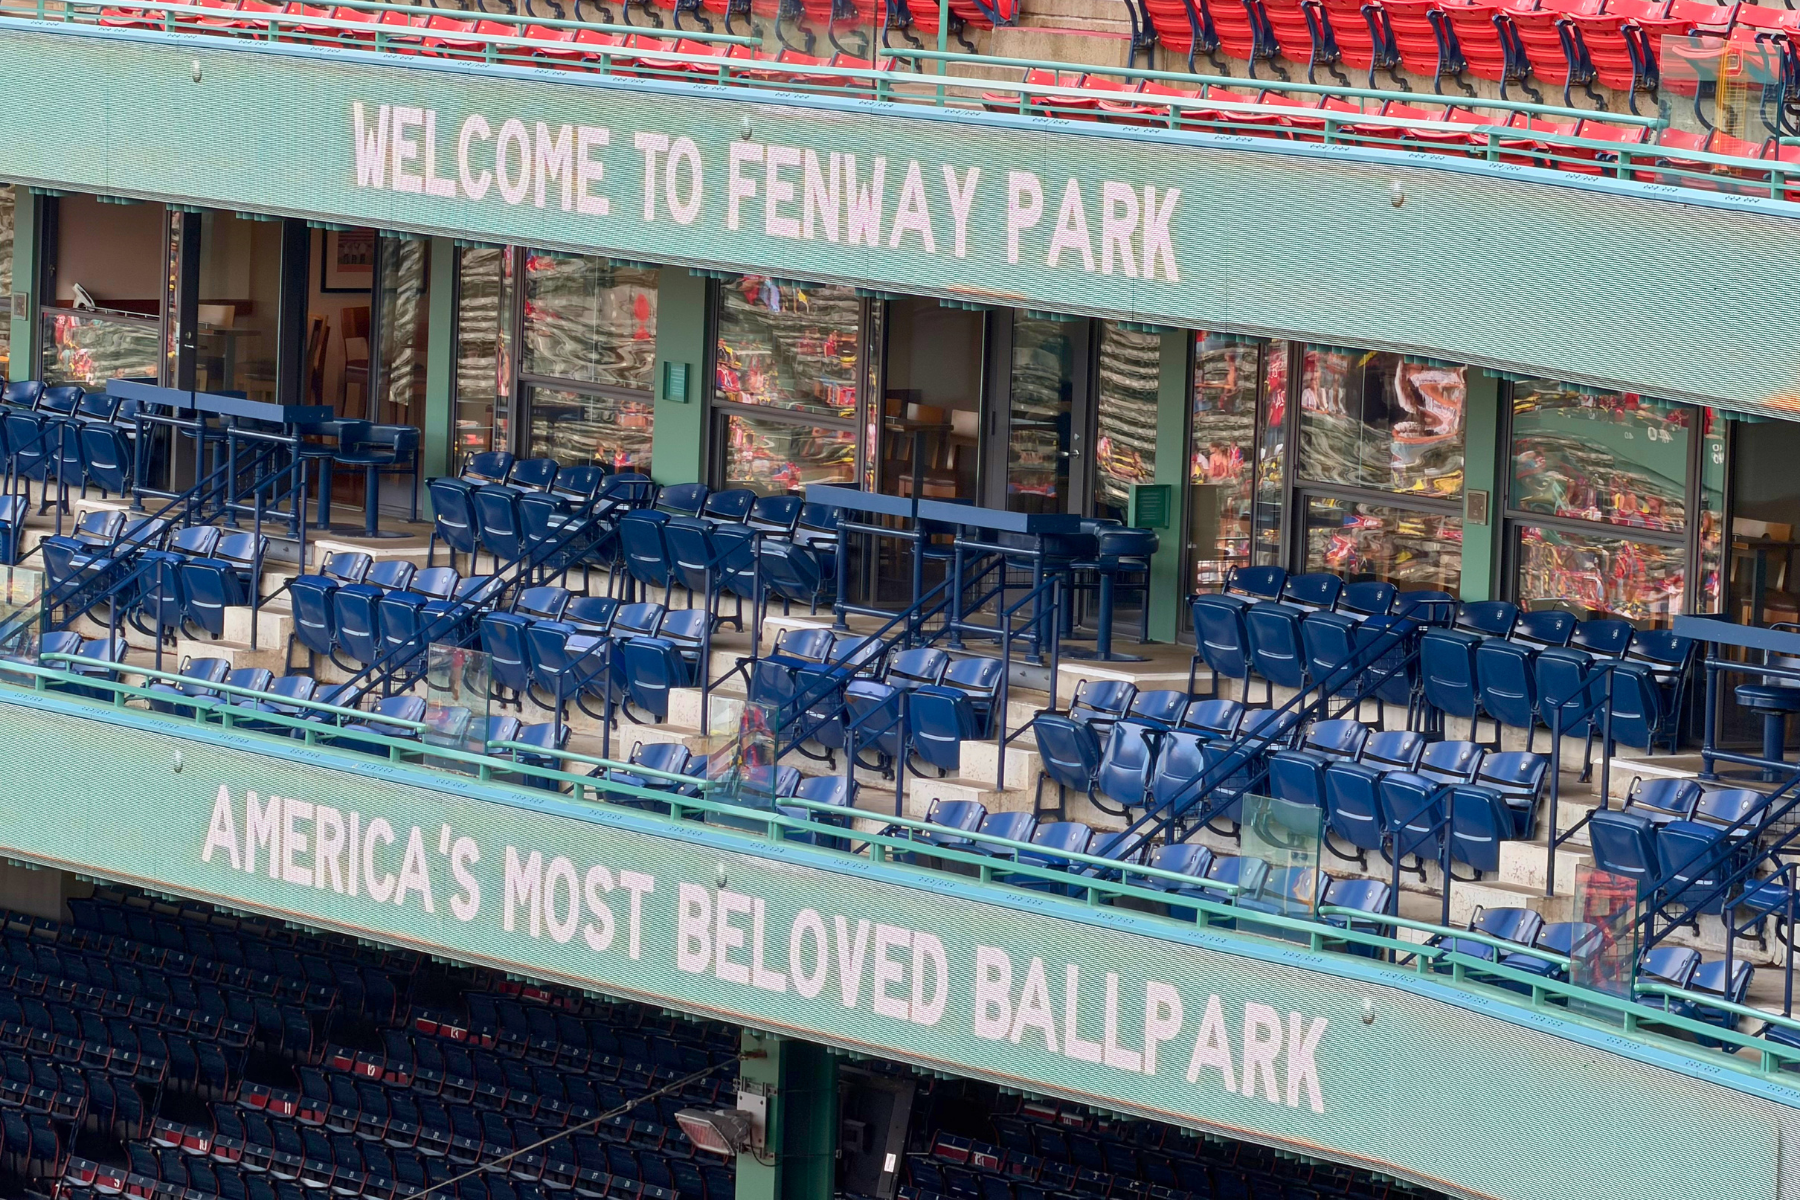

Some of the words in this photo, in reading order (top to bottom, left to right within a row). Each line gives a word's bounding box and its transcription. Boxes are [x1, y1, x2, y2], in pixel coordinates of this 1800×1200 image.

[353, 102, 610, 215] WELCOME
[633, 132, 703, 224] TO
[726, 138, 981, 258] FENWAY
[1006, 170, 1181, 282] PARK
[202, 785, 480, 921] AMERICA'S
[503, 846, 655, 959] MOST
[677, 882, 948, 1026] BELOVED
[974, 945, 1327, 1112] BALLPARK
